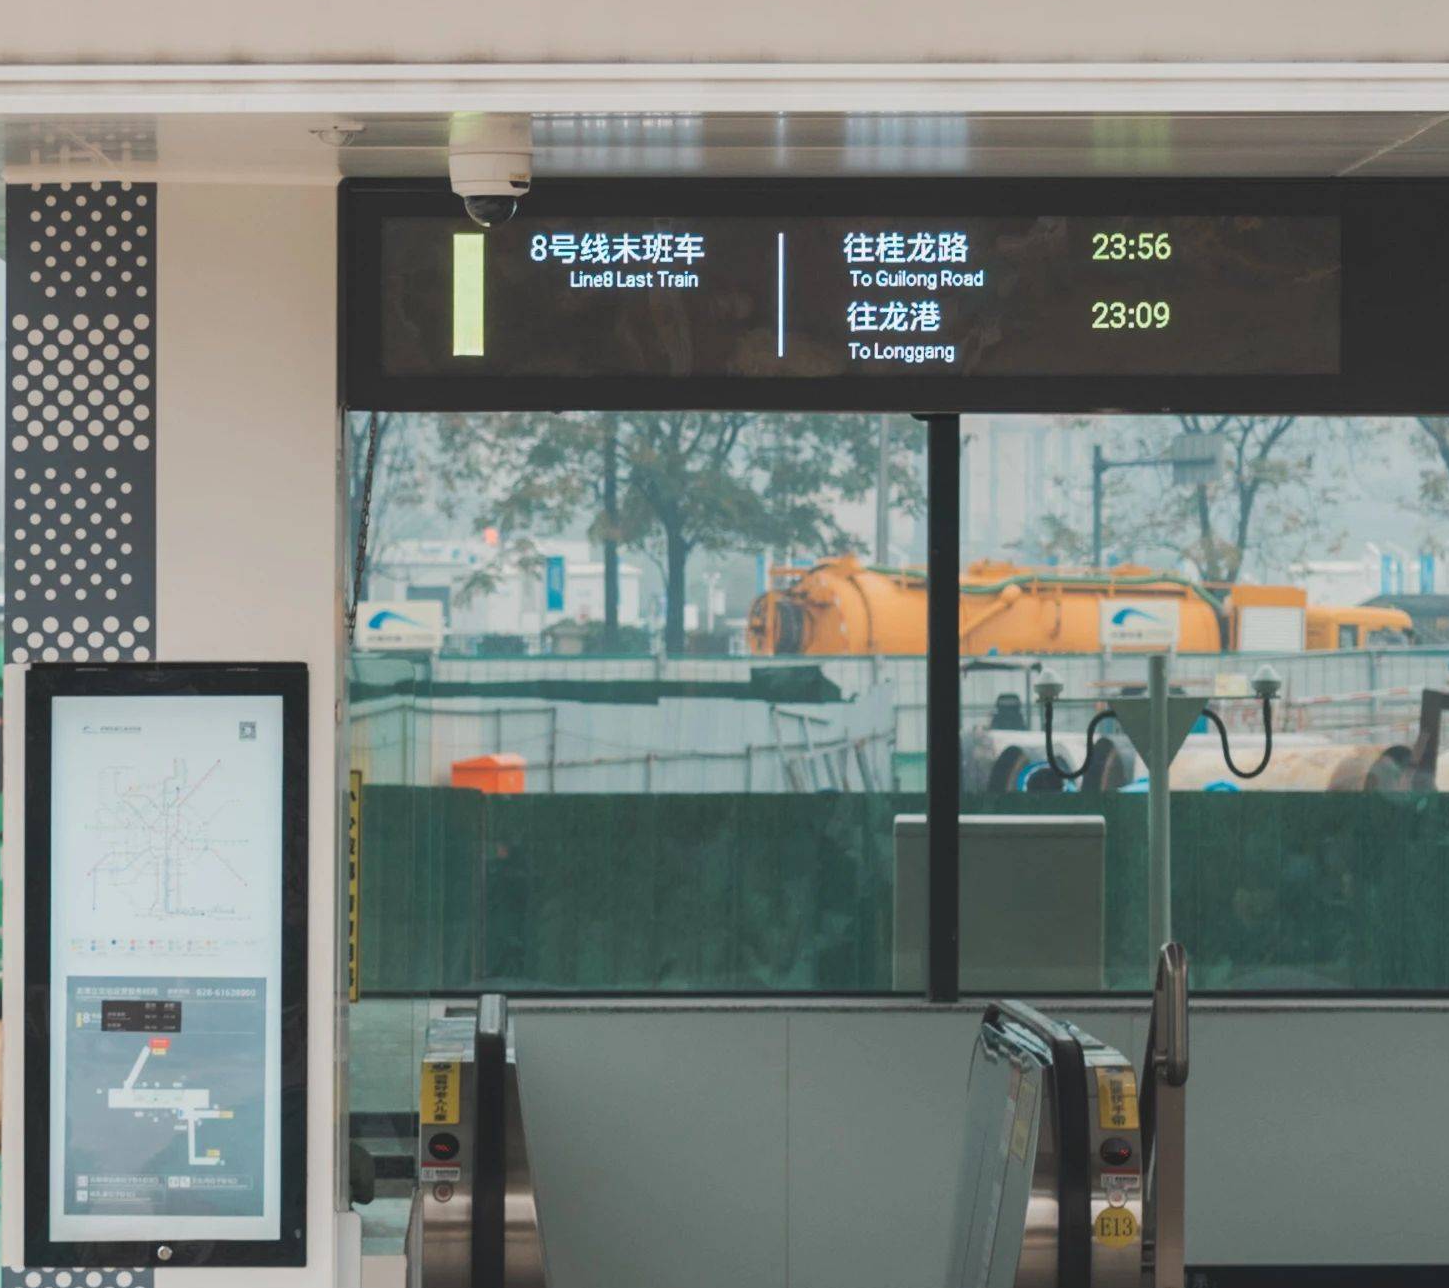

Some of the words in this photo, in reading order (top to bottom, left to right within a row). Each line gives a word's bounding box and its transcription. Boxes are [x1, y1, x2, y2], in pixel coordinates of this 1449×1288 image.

[530, 232, 705, 265] 8号线末班车
[843, 232, 969, 264] 往桂龙路
[1092, 233, 1172, 260] 23:56
[570, 271, 613, 288] Line8
[616, 271, 653, 288] Last
[657, 271, 699, 288] Train
[850, 271, 872, 287] To
[875, 270, 937, 291] Guilong
[940, 270, 984, 287] Road
[847, 301, 941, 332] 往龙港
[1091, 301, 1171, 329] 23:09
[849, 343, 871, 360] To
[874, 343, 955, 363] Longgang
[1100, 1217, 1134, 1237] E13
